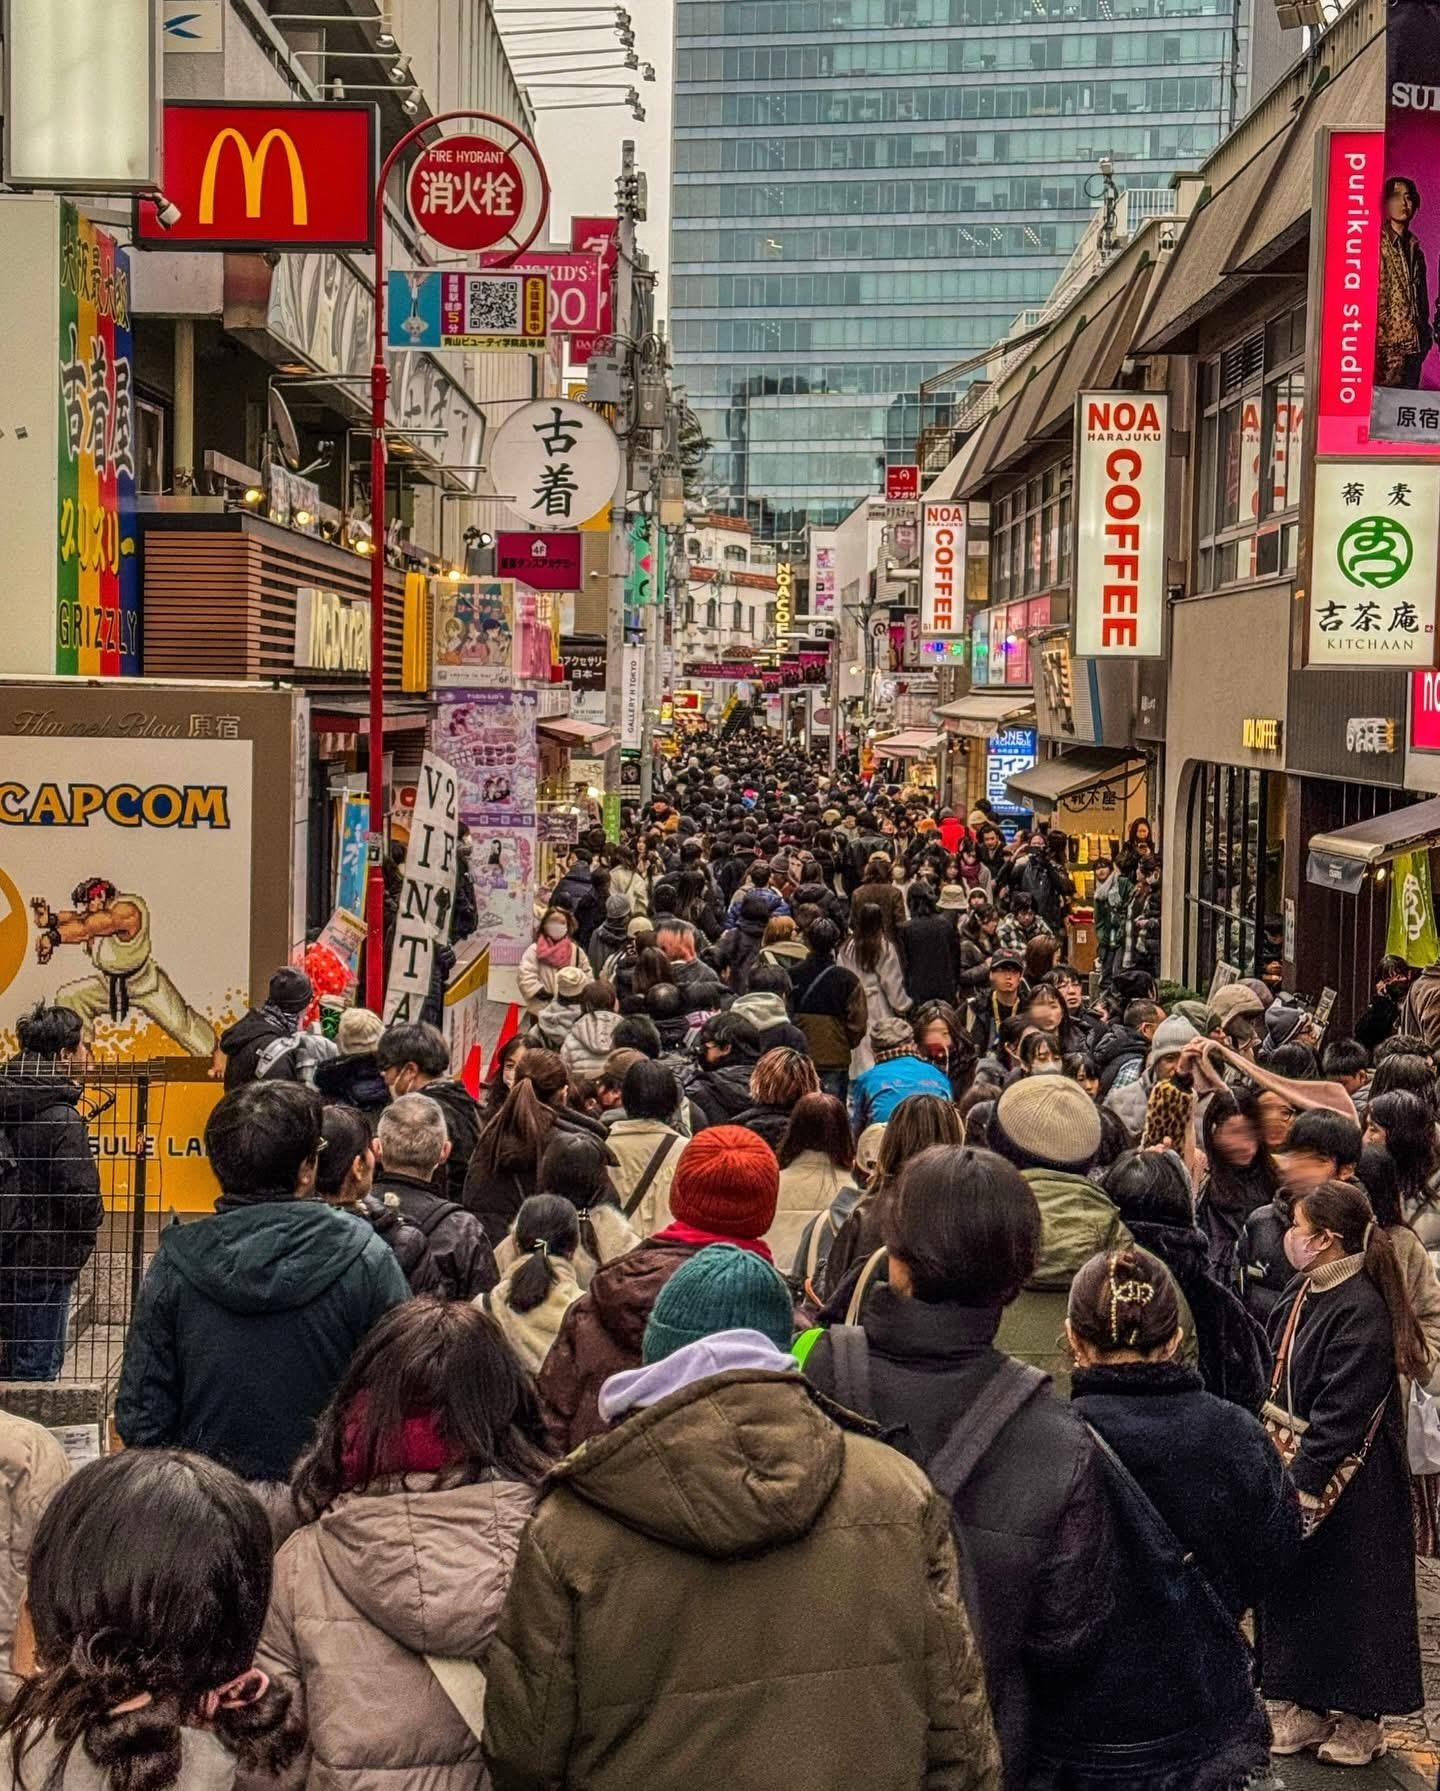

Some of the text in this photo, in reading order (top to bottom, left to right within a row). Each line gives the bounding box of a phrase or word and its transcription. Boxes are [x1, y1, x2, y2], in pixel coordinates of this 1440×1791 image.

[429, 150, 505, 164] FIRE HYDRANT
[420, 170, 517, 216] 消火栓
[1343, 153, 1369, 290] purikura
[1339, 303, 1363, 404] studio
[1087, 402, 1161, 432] NOA
[1396, 406, 1440, 429] 原宿
[1087, 432, 1162, 442] HARAJUKU
[530, 407, 583, 518] 古着
[1341, 481, 1413, 506] 蕎麦
[927, 507, 963, 522] NOA
[1102, 448, 1143, 647] COFFEE
[934, 529, 954, 630] COFFEE
[58, 600, 137, 656] GRIZZLY
[1314, 599, 1420, 634] 吉茶庵
[1327, 639, 1414, 650] KITCHAAN
[572, 669, 603, 679] 日本一
[629, 660, 637, 687] TOKYO
[188, 713, 241, 739] 原宿
[989, 758, 1030, 771] コイン
[0, 781, 231, 829] CAPCOM
[167, 1137, 209, 1157] LA
